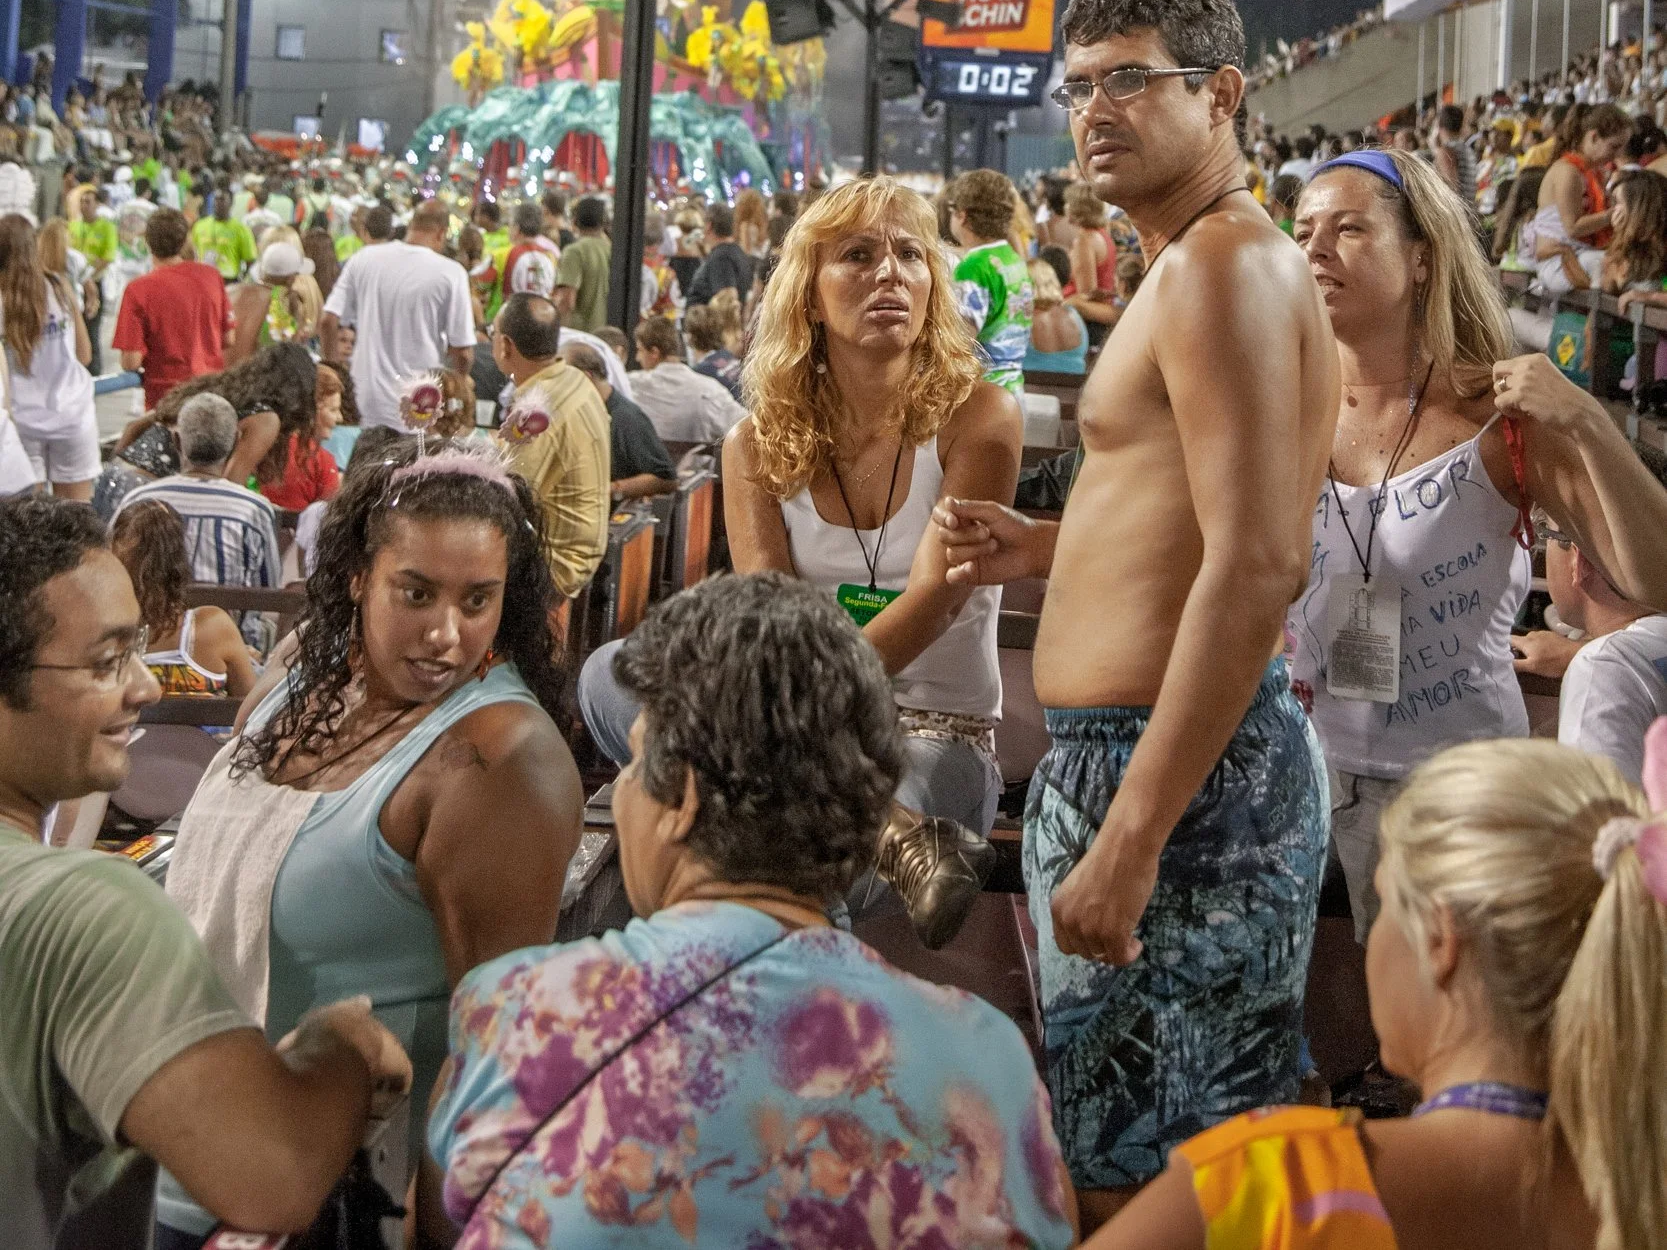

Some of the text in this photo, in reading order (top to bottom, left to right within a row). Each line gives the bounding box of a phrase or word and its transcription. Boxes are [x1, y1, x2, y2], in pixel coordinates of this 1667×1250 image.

[1420, 541, 1488, 589] ESCOLA
[858, 592, 888, 604] FRISA
[1429, 588, 1481, 624] VIDA
[1386, 668, 1481, 728] AMOR
